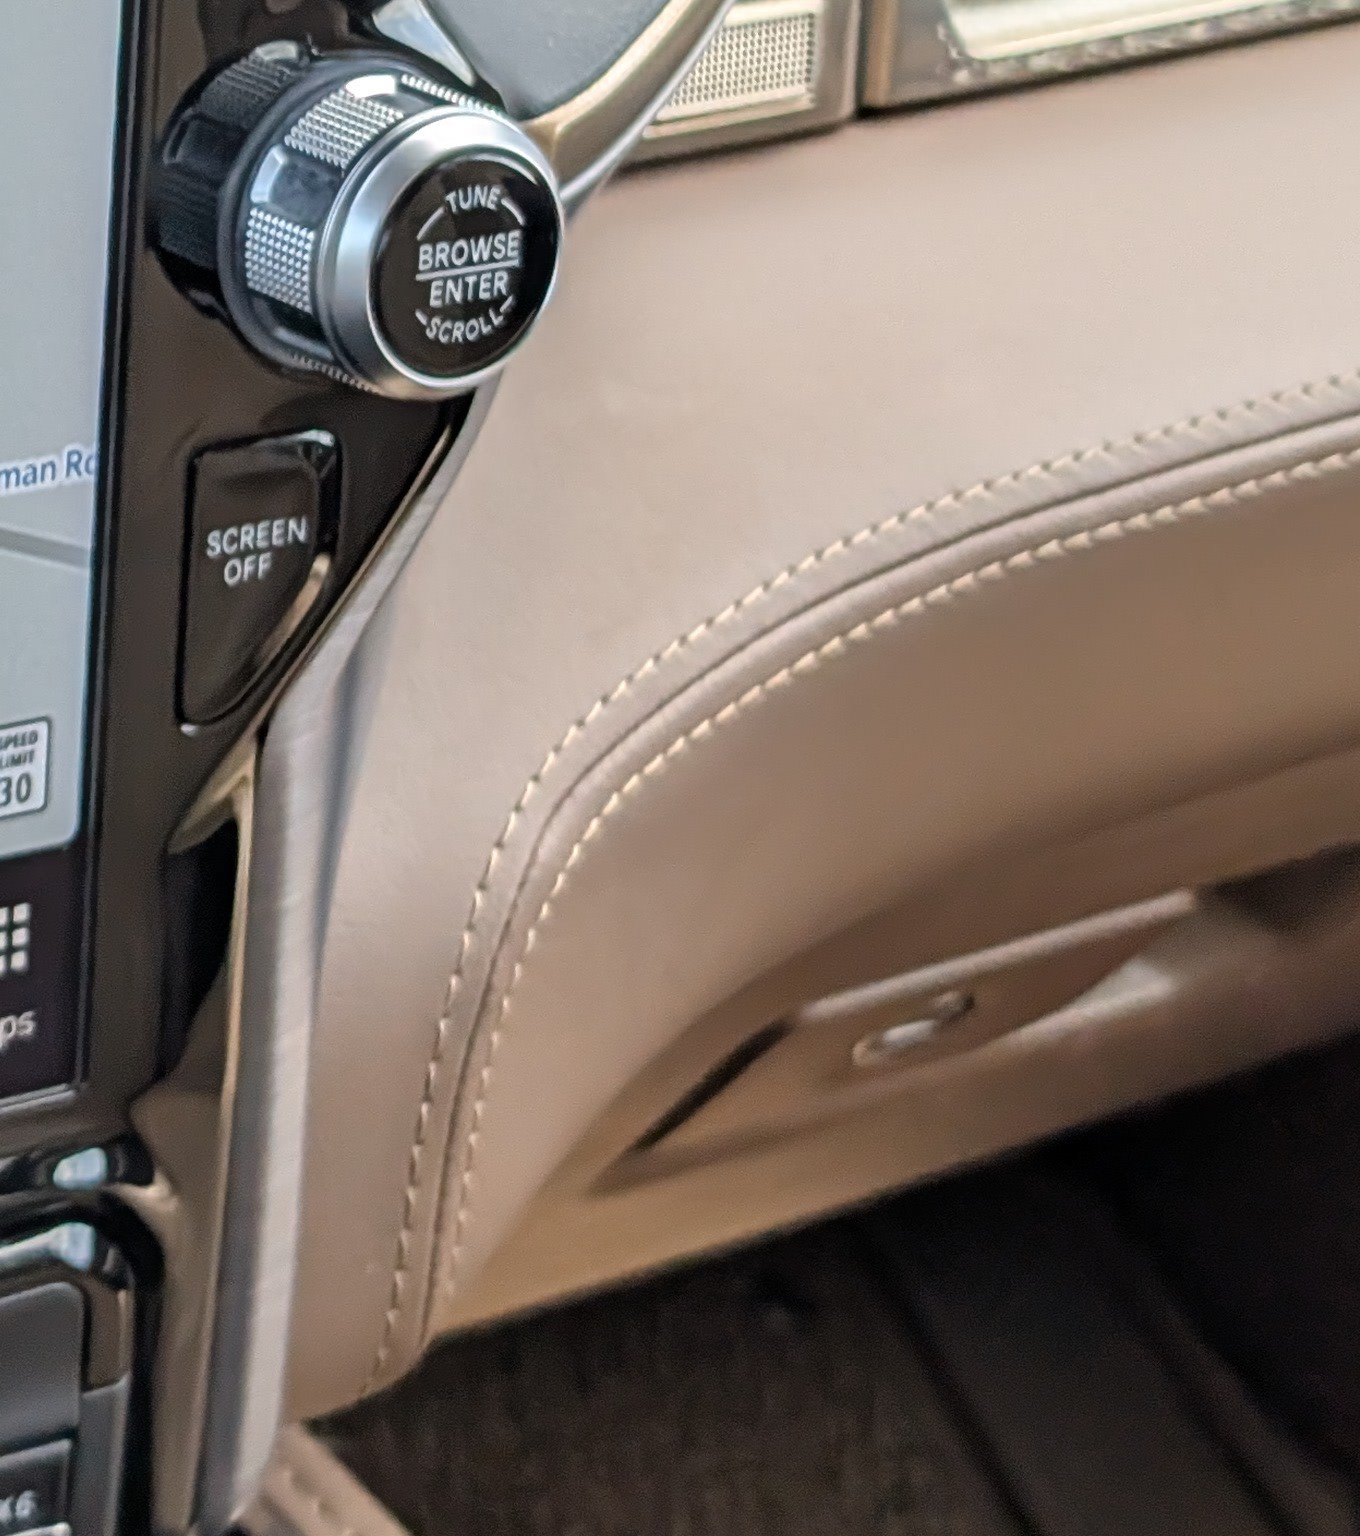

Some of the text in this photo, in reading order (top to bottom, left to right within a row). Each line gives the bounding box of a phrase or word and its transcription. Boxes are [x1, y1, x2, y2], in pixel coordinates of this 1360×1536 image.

[445, 185, 501, 213] TUNE
[418, 229, 522, 272] BROWSE
[429, 271, 509, 308] ENTER
[426, 309, 504, 344] SCROLL
[206, 517, 308, 559] SCREEN
[223, 553, 273, 587] OFF
